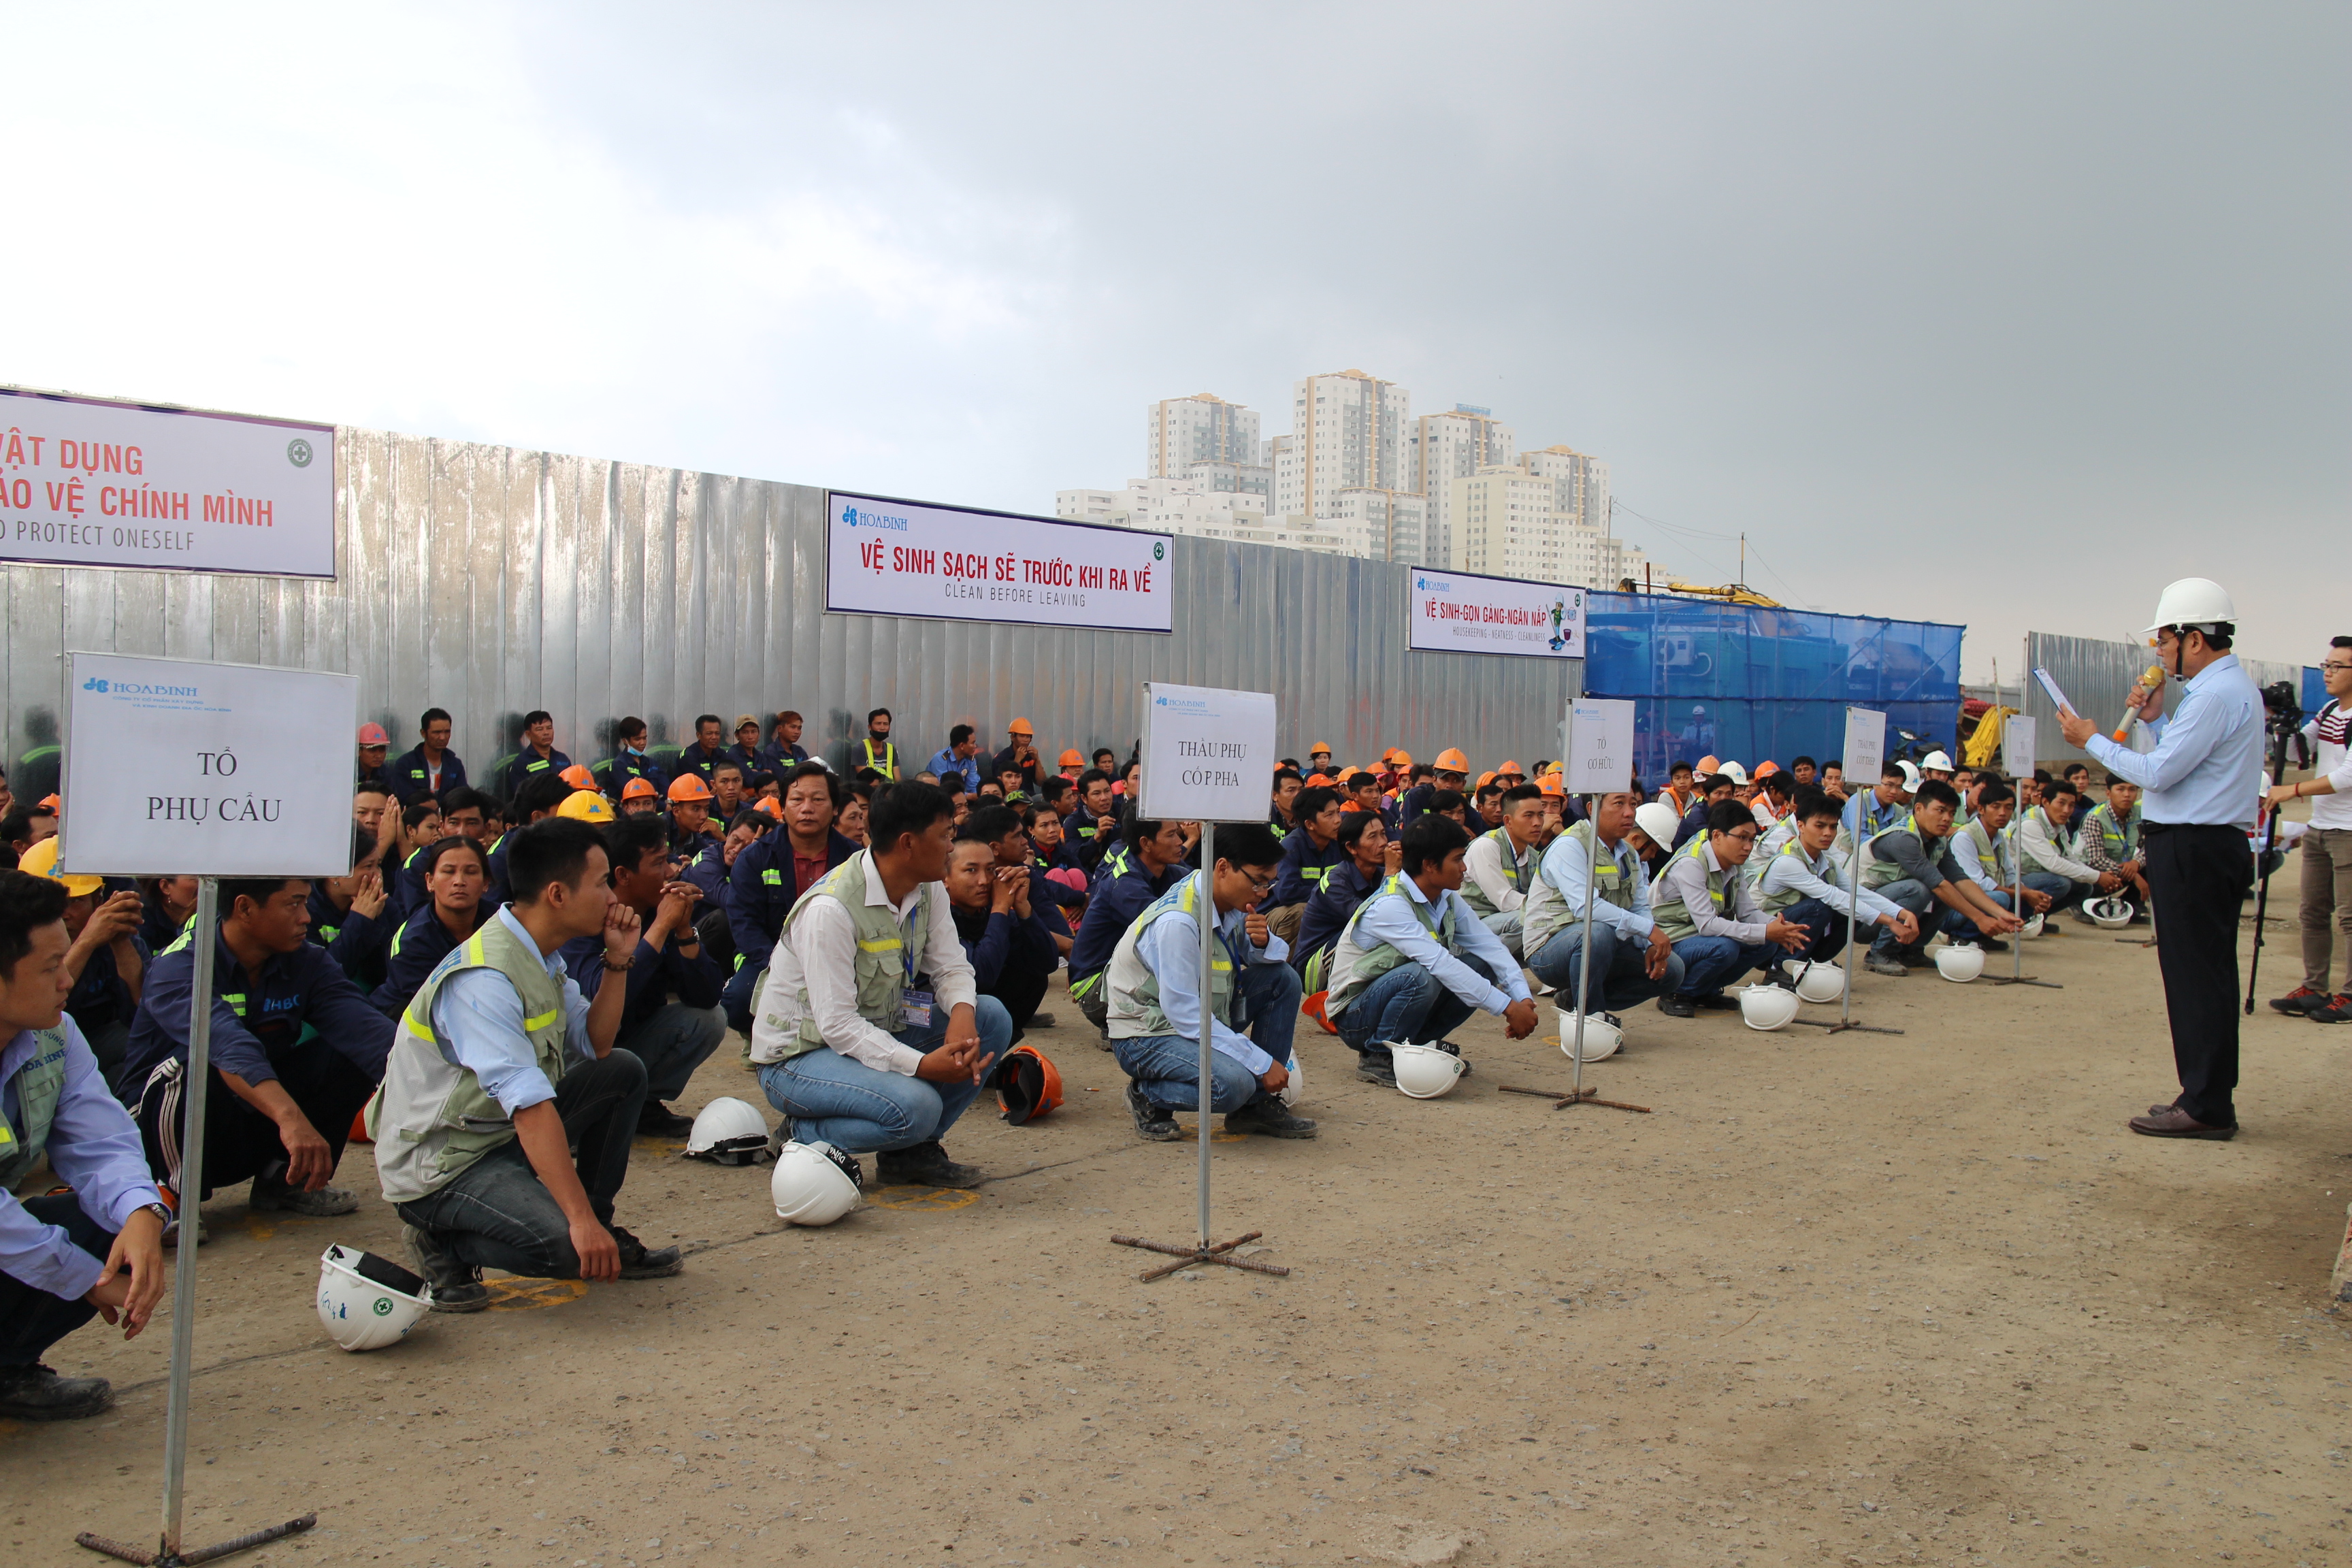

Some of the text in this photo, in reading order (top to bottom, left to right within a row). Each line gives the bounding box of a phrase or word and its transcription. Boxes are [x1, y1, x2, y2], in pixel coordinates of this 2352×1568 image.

[0, 427, 142, 476] ẬT DỤNG
[46, 476, 84, 519] VỆ
[101, 483, 189, 520] CHÍNH
[203, 489, 273, 527] MÌNH
[860, 512, 908, 531] HOABINH
[17, 521, 103, 545] PROTECT
[113, 527, 195, 551] ONESELF
[861, 538, 1152, 593] VỆ SINH SẠCH SẼ TRƯỚC KHI RA VỀ
[945, 583, 1085, 607] CLEAN BEFORE LEAVING
[1426, 581, 1450, 592] HOABINH
[1425, 597, 1437, 621] VỆ
[1531, 605, 1546, 627] NẮP
[1453, 626, 1487, 638] HOUSEKEEPING
[1492, 630, 1514, 640] NEATNESS
[1518, 631, 1546, 642] CLEANLINESS
[113, 683, 198, 696] HOABINH
[197, 746, 238, 776] TỔ
[1178, 738, 1247, 762] THẦU PHỤ
[1214, 771, 1239, 786] PHA
[146, 791, 282, 826] PHỤ CẨU
